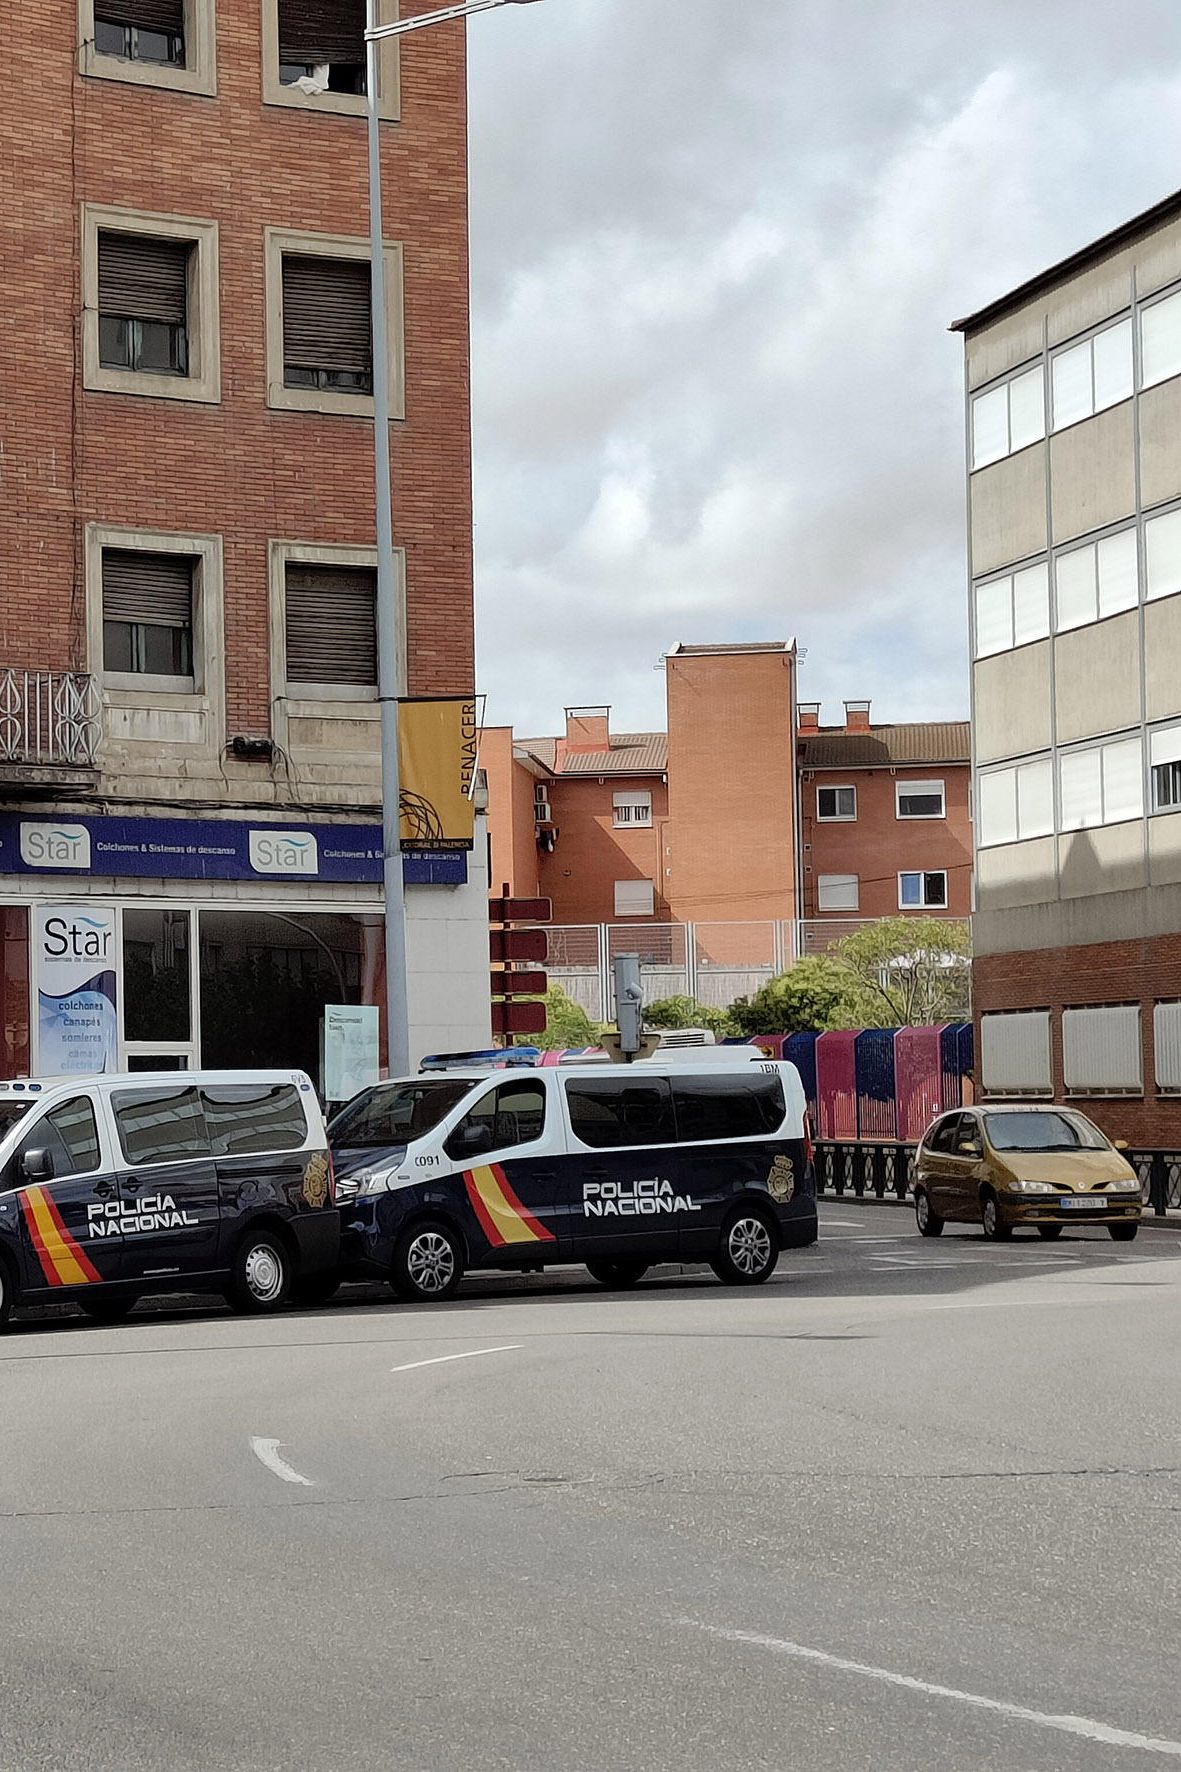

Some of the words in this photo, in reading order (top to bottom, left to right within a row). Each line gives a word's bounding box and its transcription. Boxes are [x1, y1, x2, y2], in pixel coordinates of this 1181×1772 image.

[28, 831, 82, 861] Star
[97, 842, 139, 852] Colchones
[141, 843, 147, 853] &
[149, 843, 185, 854] Sistemas
[186, 844, 197, 854] de
[198, 845, 236, 855] descanso
[257, 839, 309, 867] Star
[324, 850, 365, 859] Colchones
[423, 852, 461, 861] descanso
[44, 917, 111, 957] Star
[58, 1001, 103, 1010] colchones
[63, 1017, 100, 1027] canapés
[62, 1033, 102, 1042] somieres
[583, 1177, 674, 1200] POLICÍA
[87, 1192, 177, 1220] POLICÍA
[584, 1195, 701, 1217] NACIONAL
[89, 1210, 199, 1238] NACIONAL
